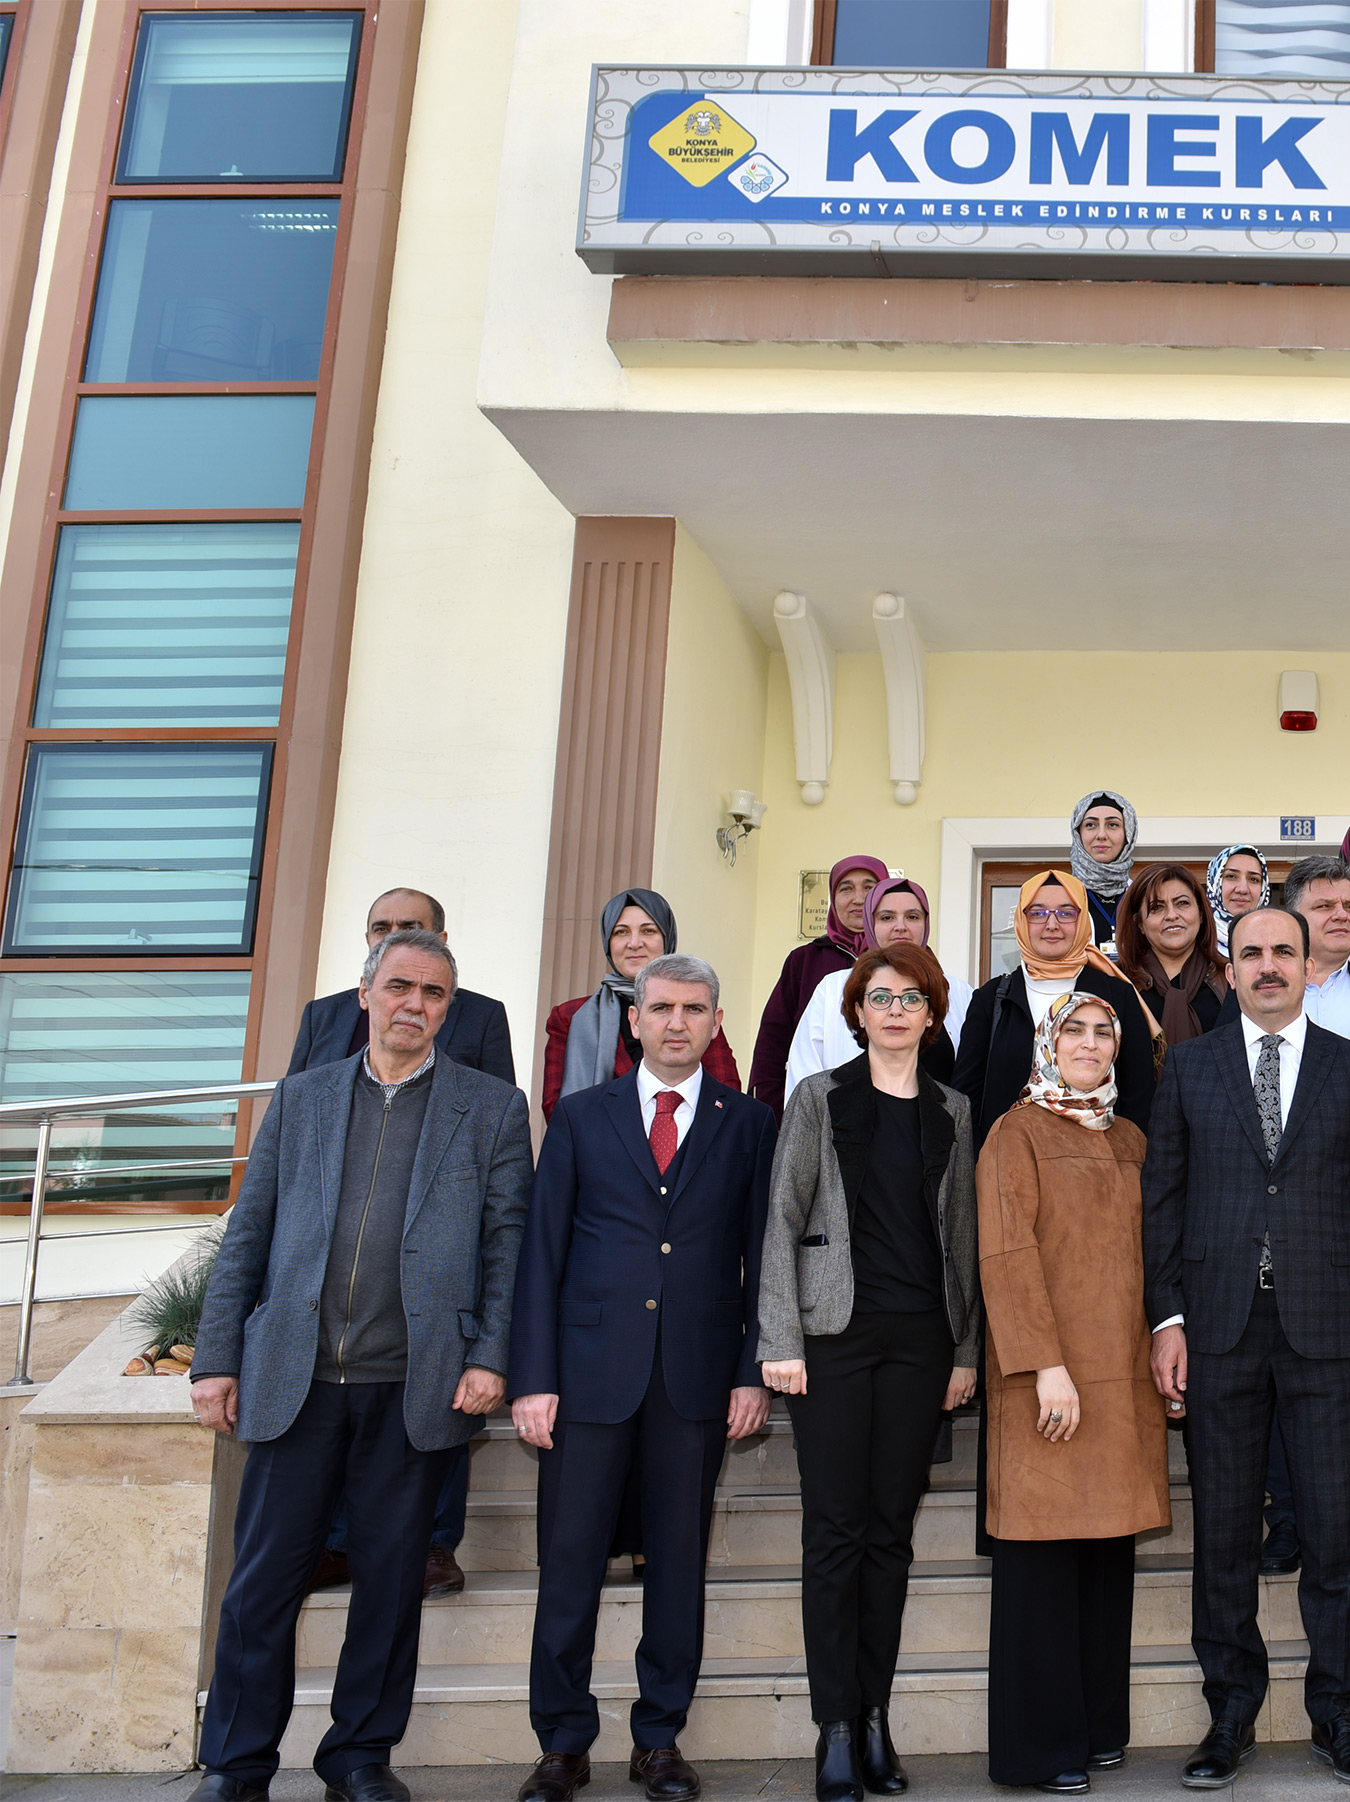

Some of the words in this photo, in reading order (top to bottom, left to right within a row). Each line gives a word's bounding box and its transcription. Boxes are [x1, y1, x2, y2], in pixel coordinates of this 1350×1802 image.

[668, 147, 734, 157] BÜYÜKŞEHİR
[825, 108, 1328, 190] KOMEK
[820, 202, 906, 215] KONYA
[921, 203, 1023, 217] MESLEK
[1039, 203, 1186, 219] EDİNDİRME
[1202, 207, 1333, 222] KURSLARI
[1284, 820, 1312, 836] 188
